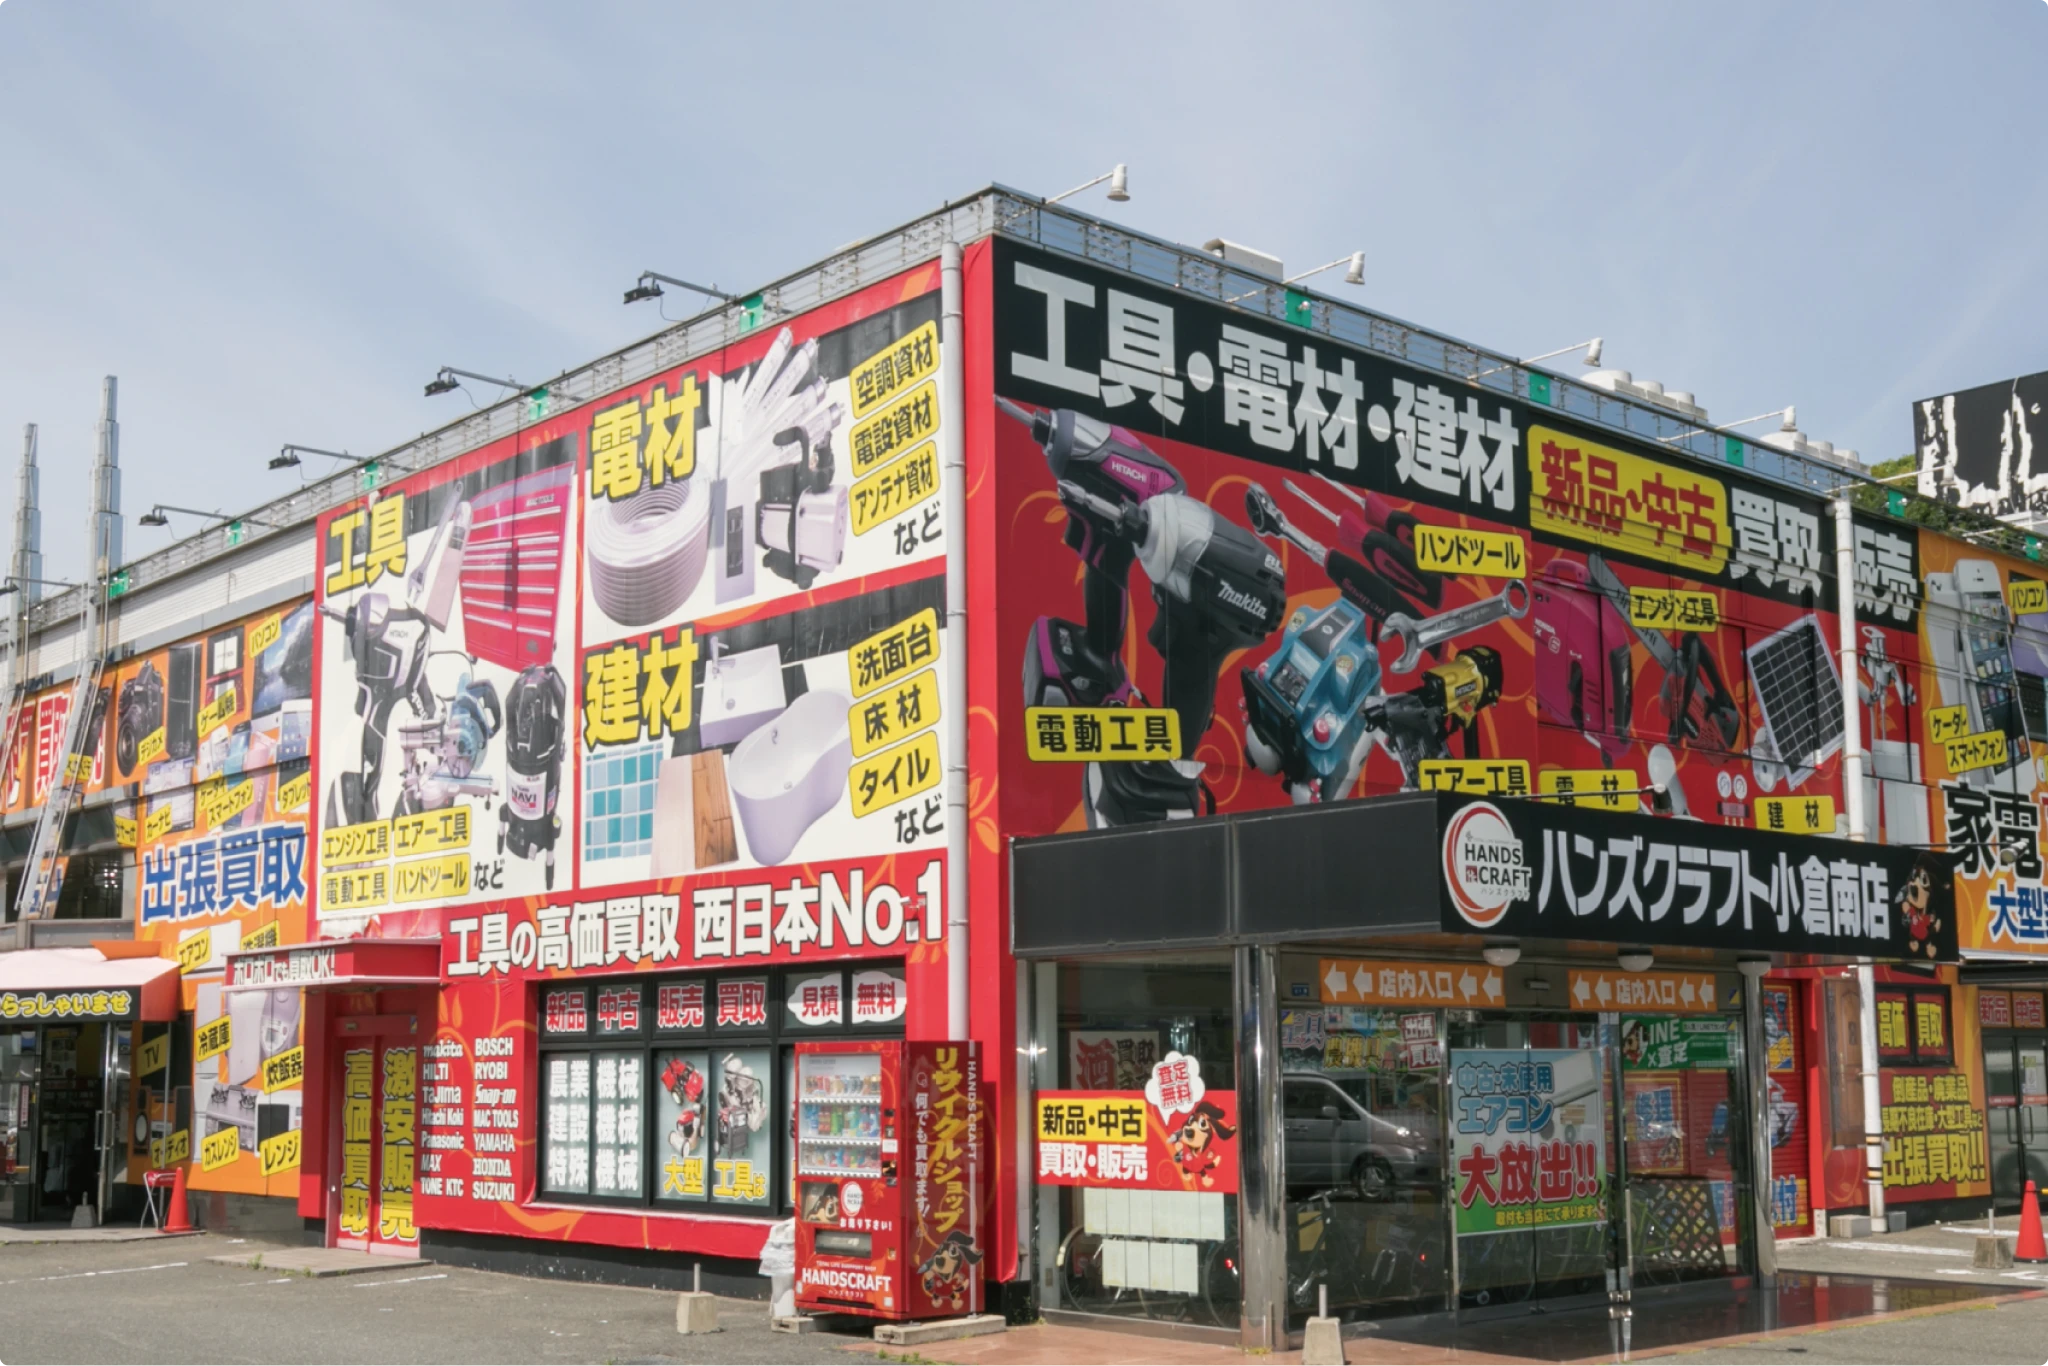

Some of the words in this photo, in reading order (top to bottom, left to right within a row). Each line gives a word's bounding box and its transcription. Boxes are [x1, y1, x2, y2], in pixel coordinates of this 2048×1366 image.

[856, 329, 934, 409] 空調資材
[1010, 261, 1519, 512] 工具・電材・建材
[591, 374, 702, 499] 電材
[855, 390, 933, 468] 電設資材
[855, 454, 934, 526] アンテナ資材
[1112, 461, 1147, 483] HITACHI
[894, 500, 943, 555] など
[1541, 439, 1717, 560] 新品・中古
[1730, 487, 1823, 597] 買取
[327, 493, 407, 597] 工具
[1420, 531, 1521, 571] ハンドツール
[1634, 589, 1718, 625] エンジン工具
[2012, 583, 2046, 611] パソコン
[251, 617, 280, 656] パソコン
[856, 621, 932, 688] 洗面台
[585, 628, 699, 748] 建材
[864, 684, 921, 745] 床材
[1036, 713, 1173, 754] 電動工具
[1948, 736, 2005, 767] スマートフォン
[859, 748, 931, 808] タイル
[1424, 766, 1528, 796] エアー工具
[1556, 775, 1620, 806] 電材
[208, 782, 254, 827] スマートフォン
[895, 793, 944, 844] など
[1767, 800, 1820, 830] 建材
[147, 808, 171, 839] カーナビ
[397, 812, 469, 849] エアー工具
[1942, 783, 2043, 879] 家電
[325, 825, 389, 859] エンジン工具
[1465, 843, 1522, 866] HANDS
[142, 824, 307, 925] 出張買取
[326, 873, 386, 906] 電動工具
[396, 860, 468, 896] ハンドツール
[474, 858, 505, 891] など
[1479, 866, 1531, 888] CRAFT
[1538, 828, 1893, 941] ハンズクラフト小倉南店
[447, 894, 681, 977] 工具の高価買取
[692, 861, 943, 960] 西日本No.1
[1990, 884, 2048, 944] 大型
[178, 937, 209, 967] エアコン
[802, 985, 839, 1017] 見積
[857, 981, 897, 1016] 無料
[1379, 968, 1455, 999] 店内入口
[1615, 977, 1676, 1006] 店内入口
[0, 991, 131, 1017] らっしゃいませ
[547, 992, 588, 1032] 新品
[599, 988, 640, 1030] 中古
[658, 984, 704, 1027] 販売
[717, 981, 766, 1026] 買取
[1979, 995, 2010, 1024] 新品
[2014, 997, 2043, 1025] 中古
[199, 1020, 230, 1056] 冷蔵庫
[1404, 1017, 1434, 1040] 出張
[1916, 1001, 1944, 1048] 買取
[144, 1044, 160, 1068] TV
[424, 1039, 463, 1059] makita
[474, 1037, 514, 1057] BOSCH
[1116, 1037, 1156, 1066] 買取
[1411, 1043, 1441, 1067] 買取
[266, 1050, 304, 1086] 炊飯器
[423, 1063, 448, 1080] HILTI
[474, 1061, 508, 1080] RYOBI
[549, 1057, 640, 1100] 農業機械
[1158, 1060, 1188, 1086] 査定
[1457, 1061, 1554, 1095] 中古・未使用
[474, 1083, 517, 1108] Snap-on
[1161, 1083, 1192, 1109] 無料
[473, 1109, 491, 1129] MAC
[492, 1109, 519, 1129] TOOLS
[549, 1102, 640, 1146] 建設機械
[1043, 1105, 1143, 1137] 新品・中古
[1457, 1094, 1554, 1135] エアコン
[204, 1133, 238, 1167] ガスレンジ
[263, 1134, 299, 1171] レンジ
[340, 1049, 372, 1236] 高価買取
[421, 1131, 464, 1150] Panasonic
[473, 1133, 516, 1152] YAMAHA
[932, 1047, 965, 1233] リサイクルショップ
[421, 1154, 442, 1172] MAX
[472, 1158, 512, 1177] HONDA
[549, 1148, 640, 1191] 特殊機械
[663, 1157, 766, 1200] 大型工具は
[1039, 1143, 1148, 1181] 買取・販売
[1459, 1139, 1598, 1208] 大放出!!
[1883, 1133, 1986, 1189] 出張買取!!
[420, 1177, 443, 1196] TONE
[445, 1178, 464, 1197] KTC
[472, 1181, 515, 1202] SUZUKI
[802, 1268, 892, 1293] HANDSCRAFT
